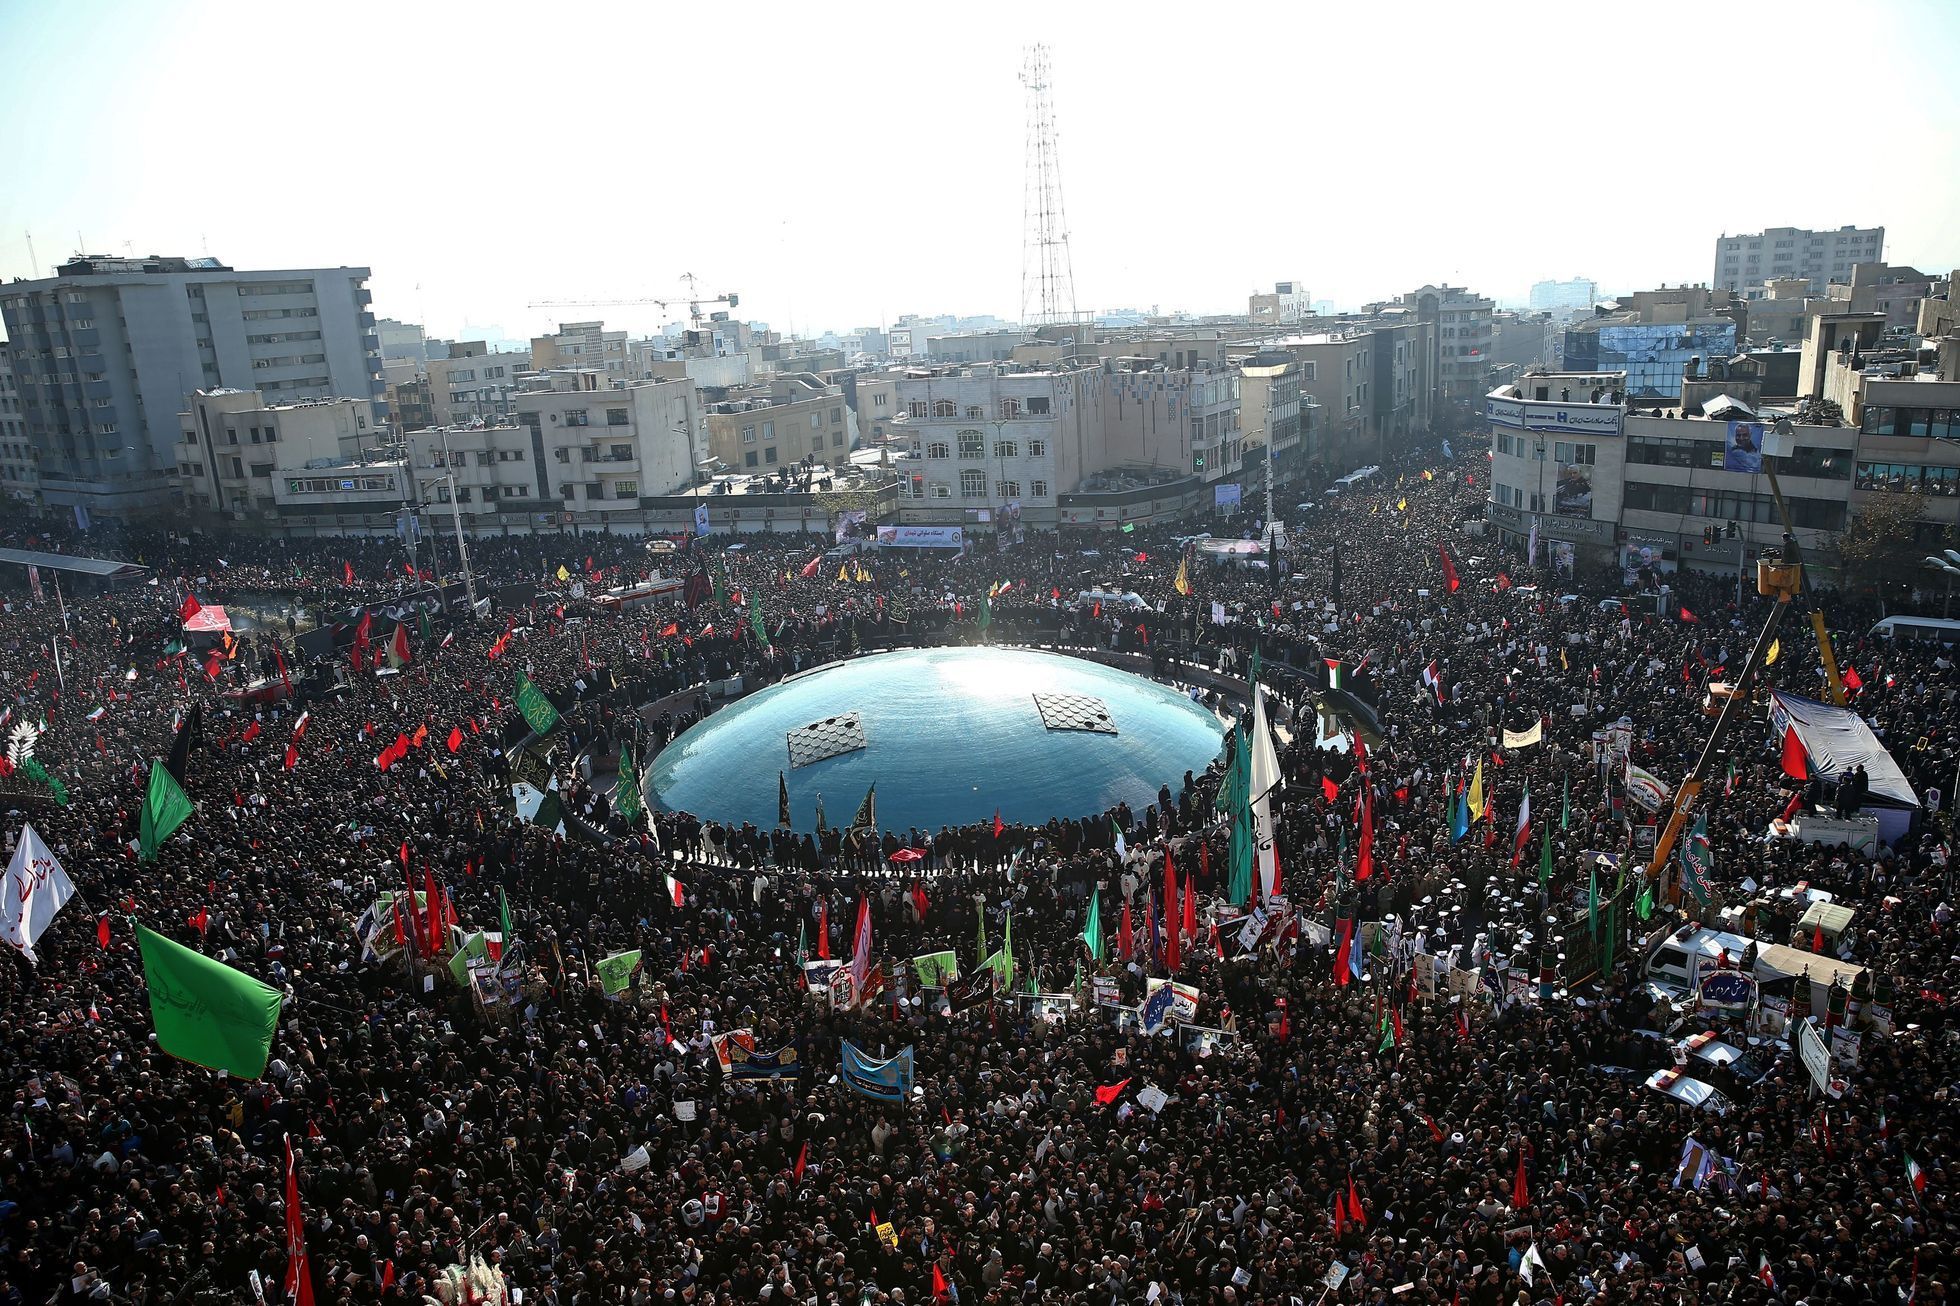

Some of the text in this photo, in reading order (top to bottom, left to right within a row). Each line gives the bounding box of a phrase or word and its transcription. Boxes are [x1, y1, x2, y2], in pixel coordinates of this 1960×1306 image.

[1583, 416, 1604, 424] صادرات
[1604, 415, 1619, 427] بانک
[1716, 986, 1730, 999] مردم
